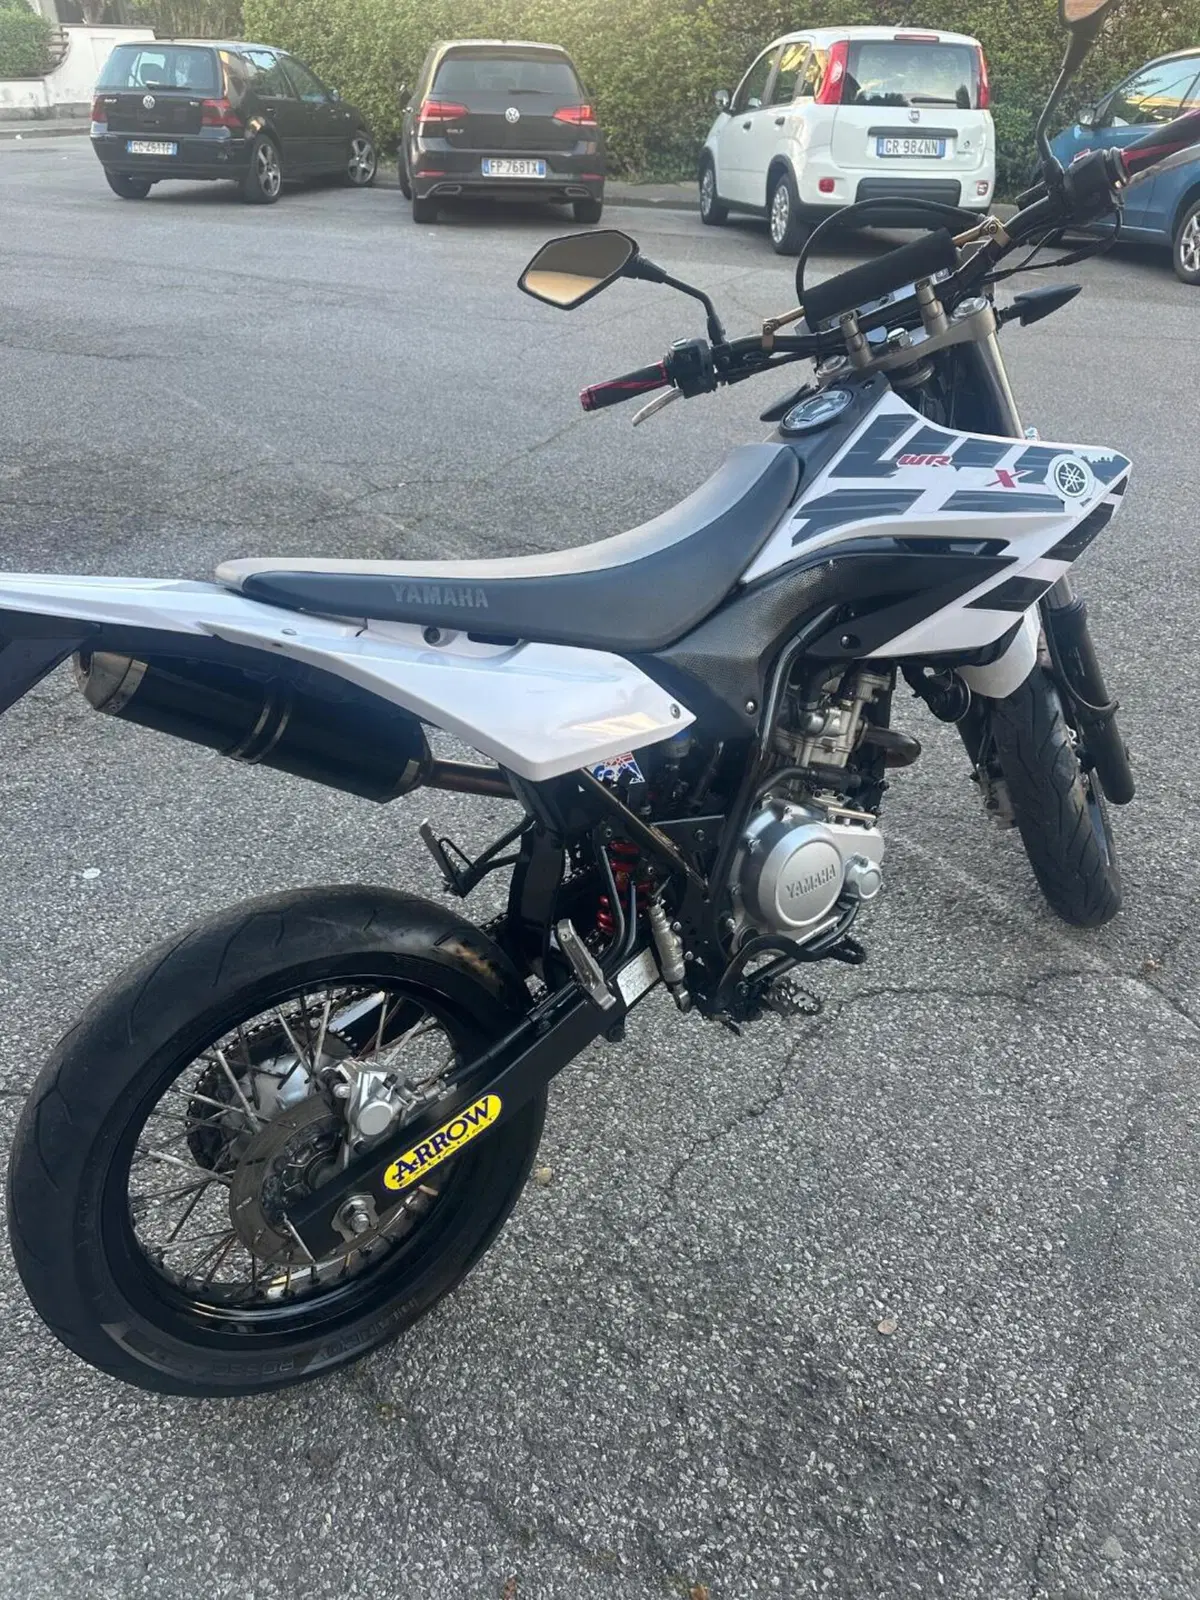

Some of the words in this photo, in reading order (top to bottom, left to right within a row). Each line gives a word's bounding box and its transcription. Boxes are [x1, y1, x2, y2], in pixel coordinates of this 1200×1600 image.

[898, 455, 951, 466] WR
[389, 583, 489, 608] YAMAHA
[785, 864, 837, 899] YAMAHA
[391, 1097, 490, 1183] ARROW
